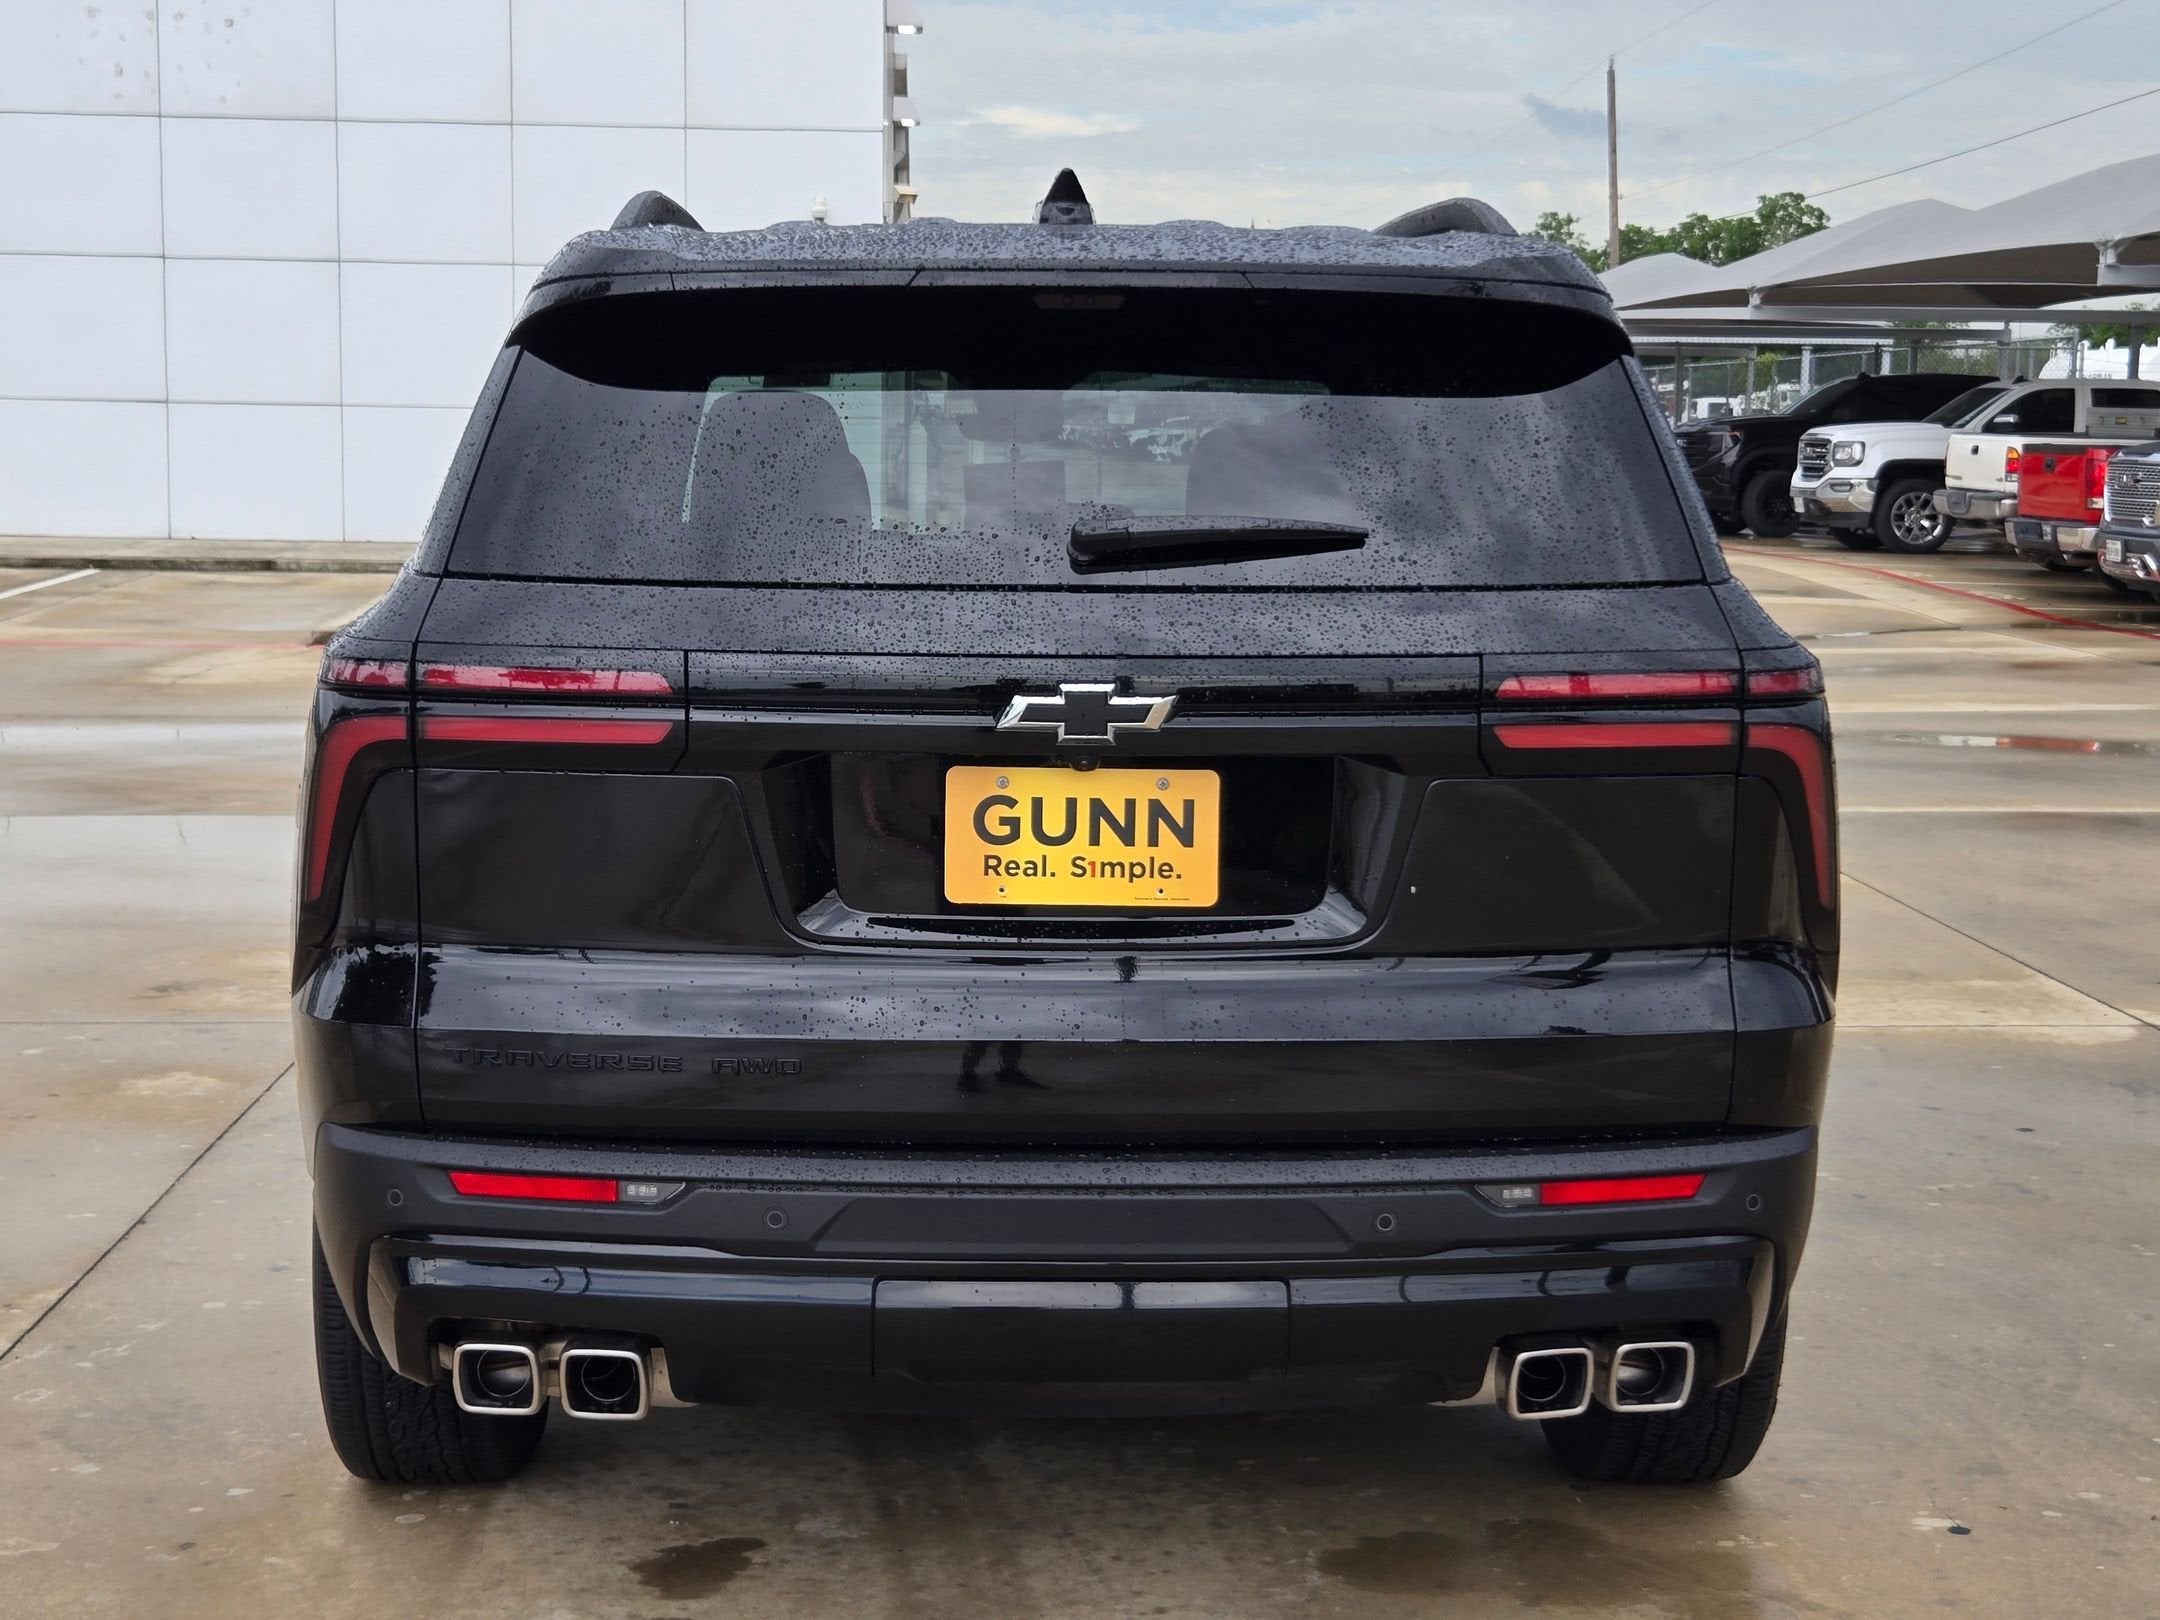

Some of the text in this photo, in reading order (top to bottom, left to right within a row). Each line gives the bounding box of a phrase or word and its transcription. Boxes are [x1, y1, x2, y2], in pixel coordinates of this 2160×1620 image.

[973, 794, 1195, 848] GUNN
[983, 854, 1056, 878] Real.
[445, 1047, 802, 1077] TRAVERSE AWD
